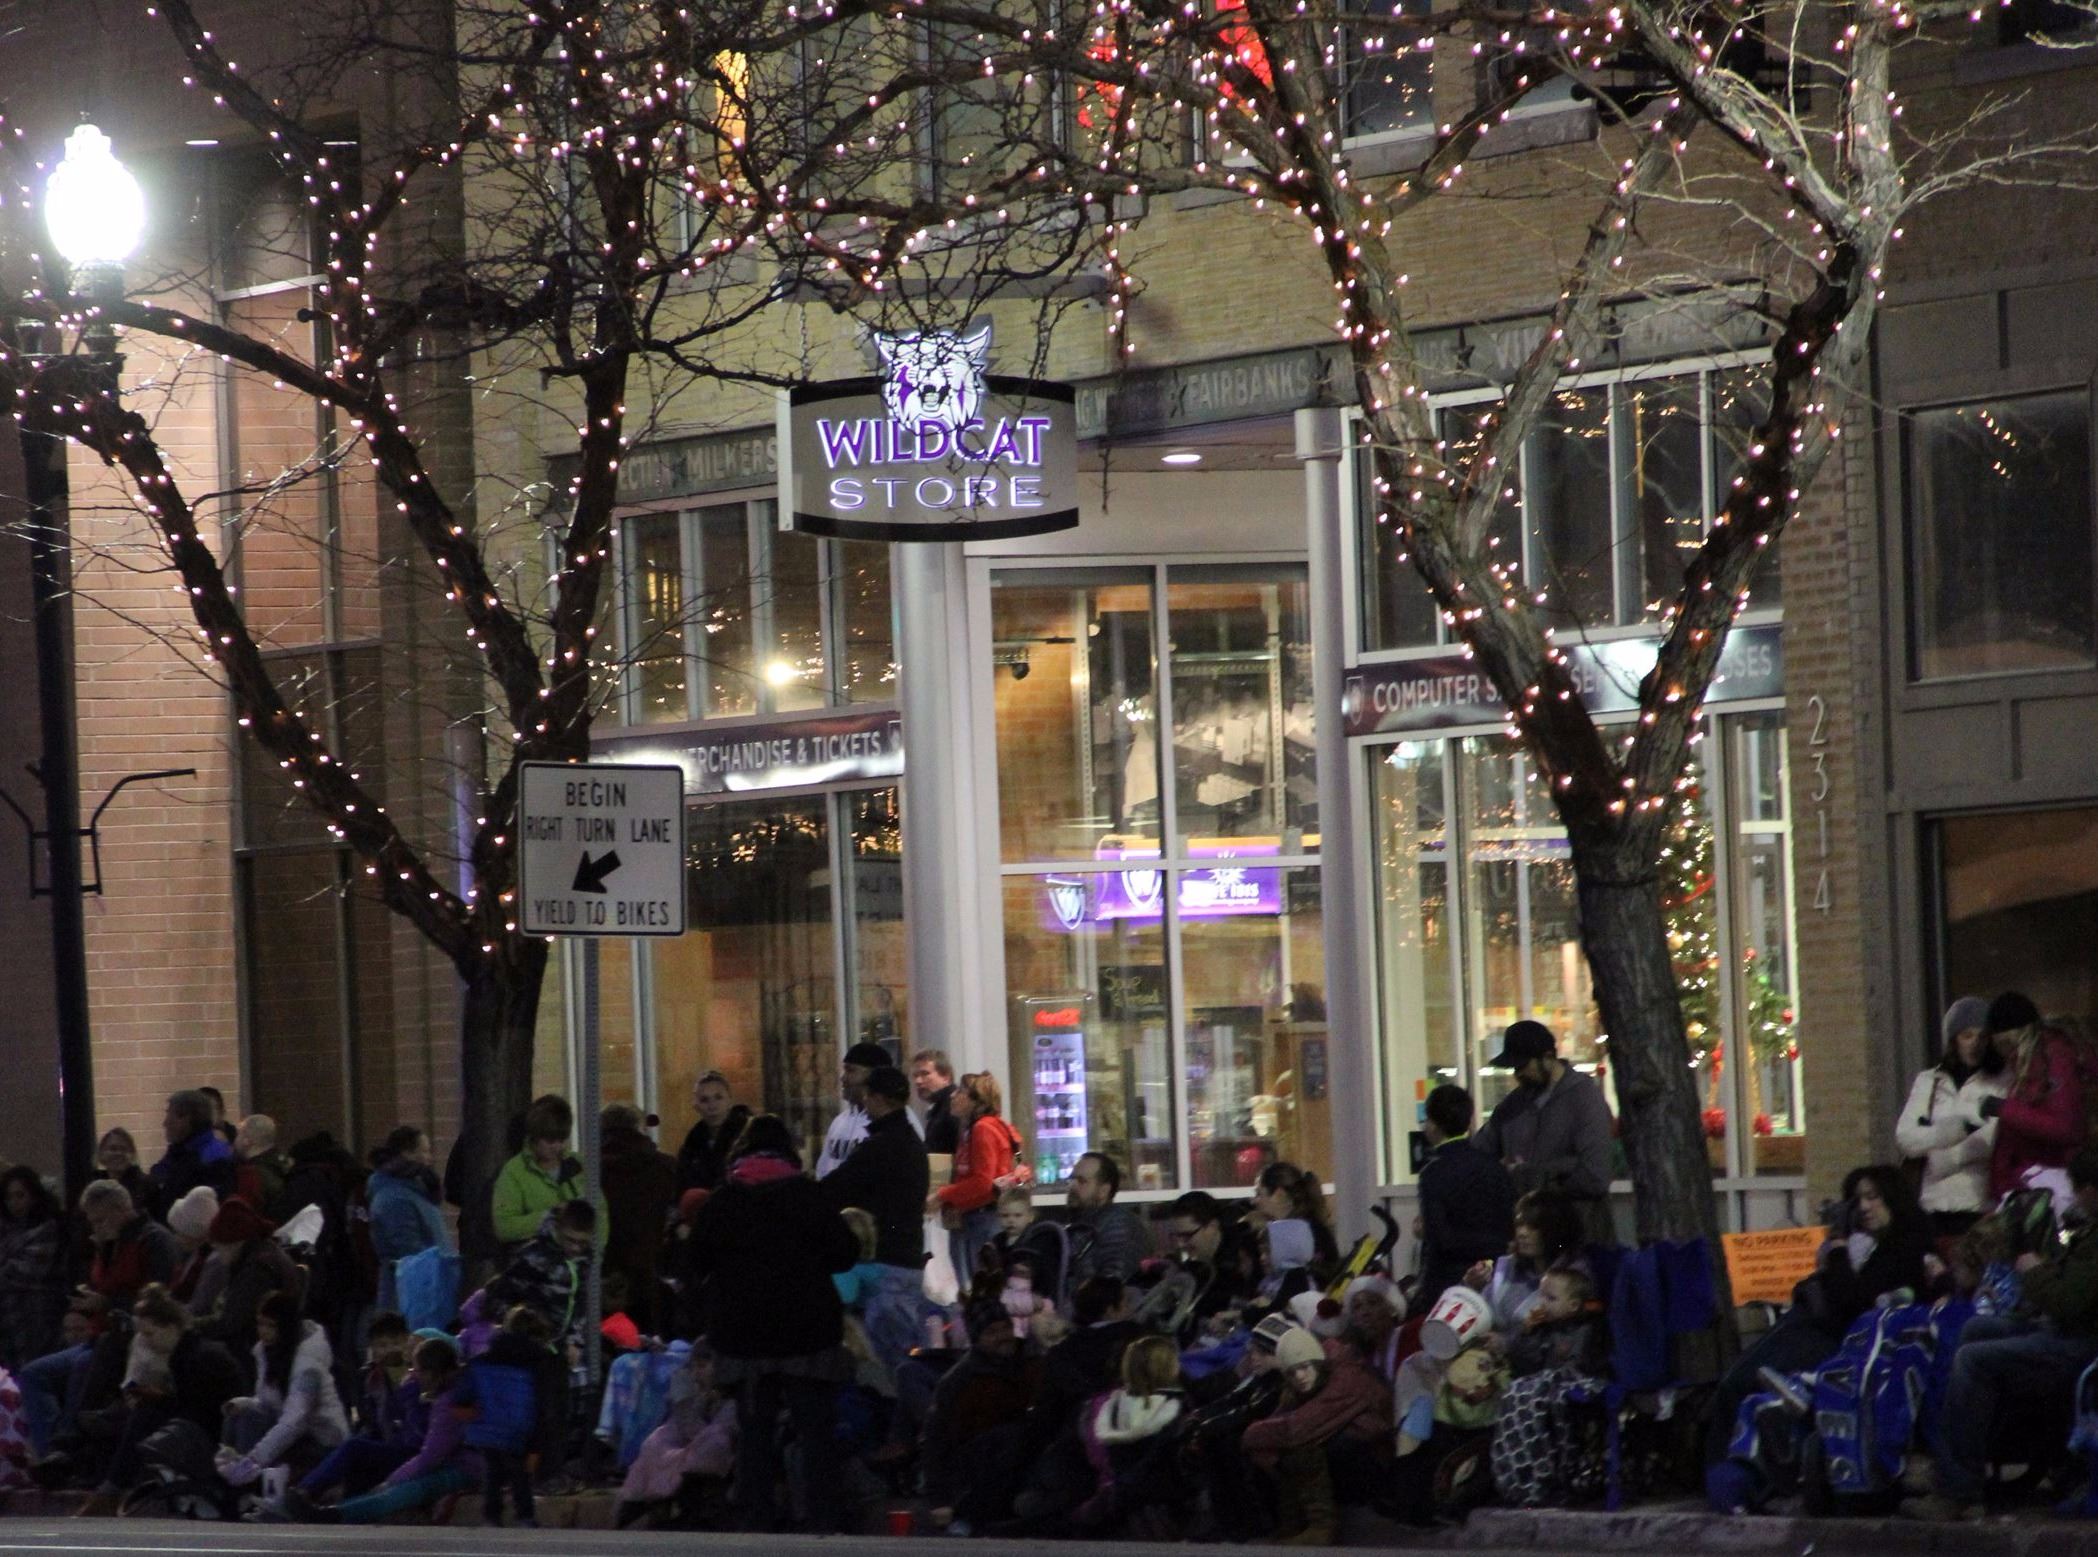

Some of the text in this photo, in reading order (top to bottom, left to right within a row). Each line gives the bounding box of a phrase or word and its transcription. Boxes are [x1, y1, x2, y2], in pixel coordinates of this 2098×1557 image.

[1187, 357, 1310, 411] FAIRBANKS
[686, 435, 776, 482] MILKERS
[816, 415, 1050, 469] WILDCAT
[829, 475, 1044, 510] STORE
[1373, 673, 1481, 712] COMPUTER
[796, 737, 807, 764] &
[811, 730, 882, 763] TICKETS
[565, 782, 627, 807] BEGIN
[1808, 695, 1831, 916] 2314
[525, 816, 671, 843] RIGHT TURN LANE
[534, 899, 670, 926] YIELD TO BIKES
